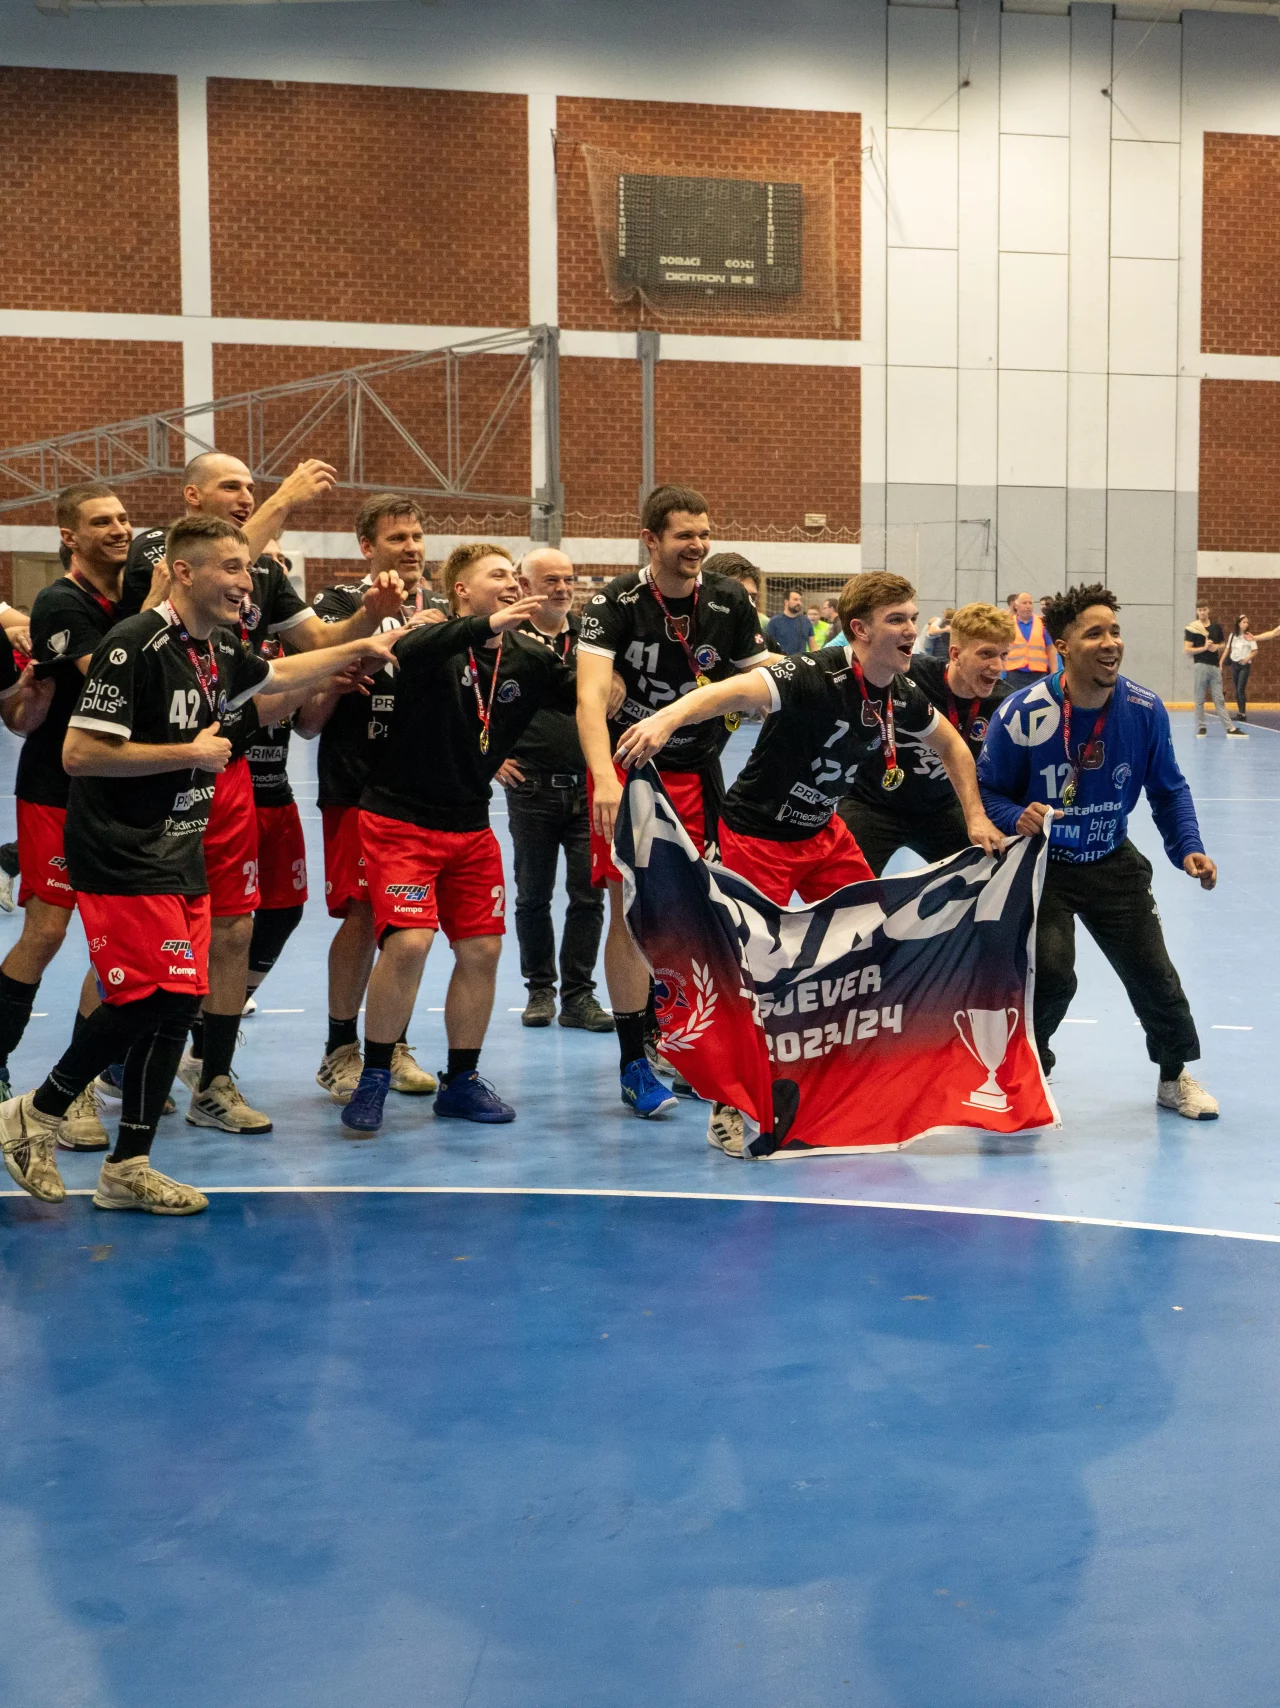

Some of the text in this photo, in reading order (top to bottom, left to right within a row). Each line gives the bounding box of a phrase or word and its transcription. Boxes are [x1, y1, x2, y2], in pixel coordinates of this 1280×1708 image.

[665, 272, 725, 283] DIGITRON
[624, 641, 660, 674] 41
[86, 679, 120, 699] biro
[169, 689, 200, 730] 42
[824, 719, 849, 748] 7
[1039, 763, 1075, 799] 12
[394, 905, 423, 914] Kempa
